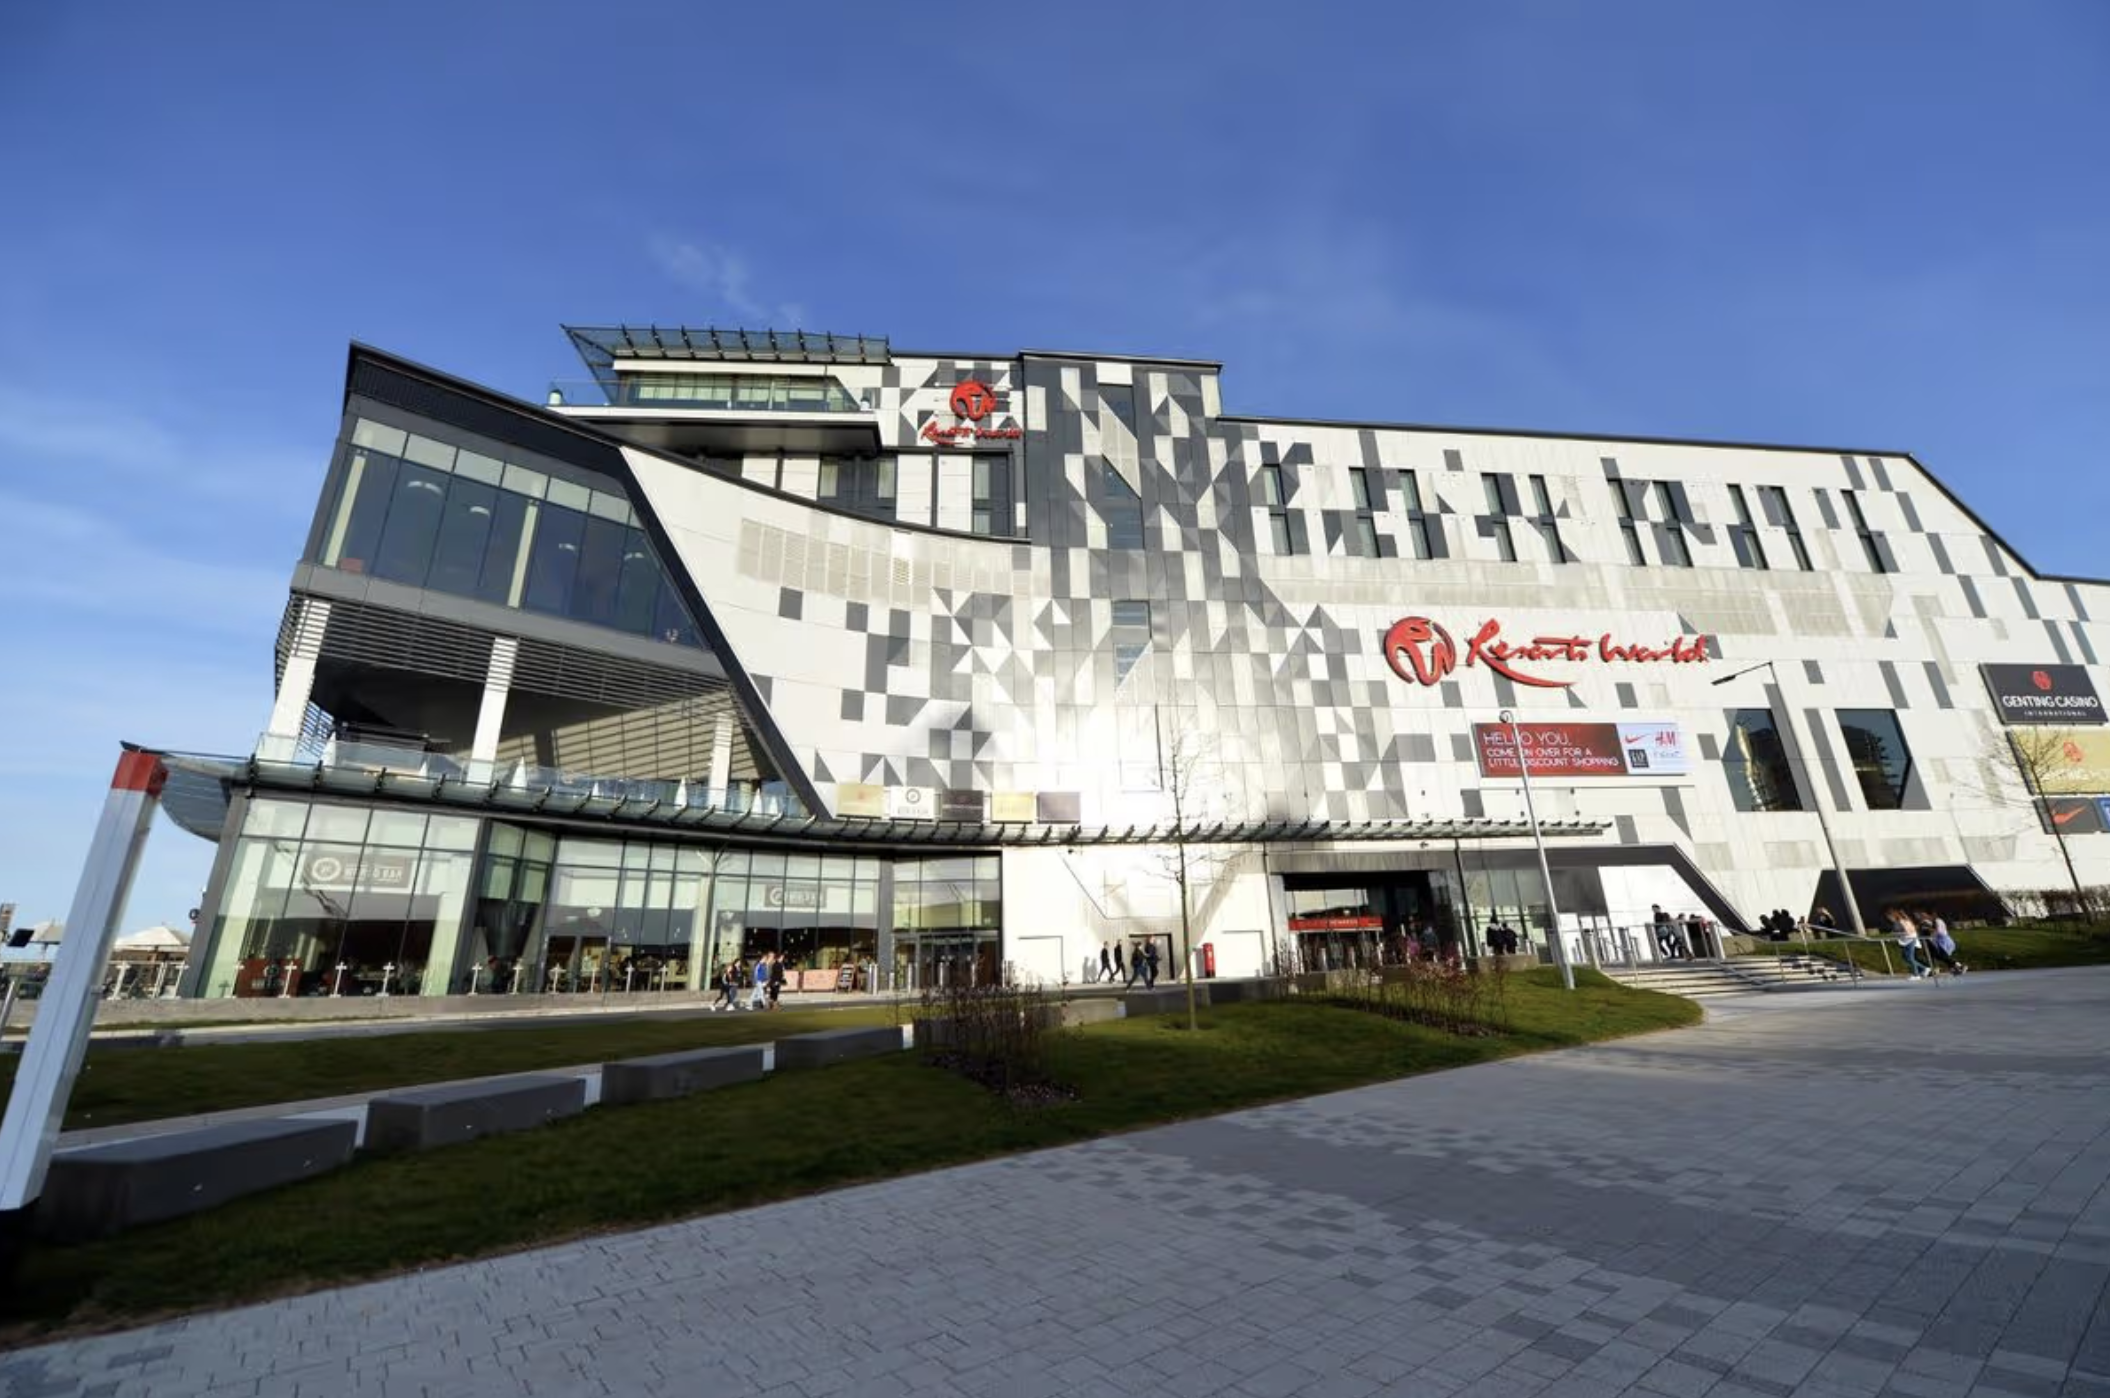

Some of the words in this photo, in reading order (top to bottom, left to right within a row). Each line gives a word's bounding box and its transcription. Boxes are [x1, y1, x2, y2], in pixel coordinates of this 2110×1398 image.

[1464, 618, 1593, 688] Resorts
[1599, 633, 1710, 663] World
[2002, 695, 2055, 708] GENTING
[2056, 695, 2098, 708] CASINO
[1483, 731, 1533, 746] HELLO
[1486, 747, 1517, 757] COME
[1535, 747, 1561, 757] OVER
[1563, 747, 1582, 757] FOR
[1585, 748, 1593, 757] A
[1488, 757, 1520, 768] LITTLE
[1523, 757, 1569, 767] DISCOUNT
[1571, 756, 1620, 767] SHOPPING
